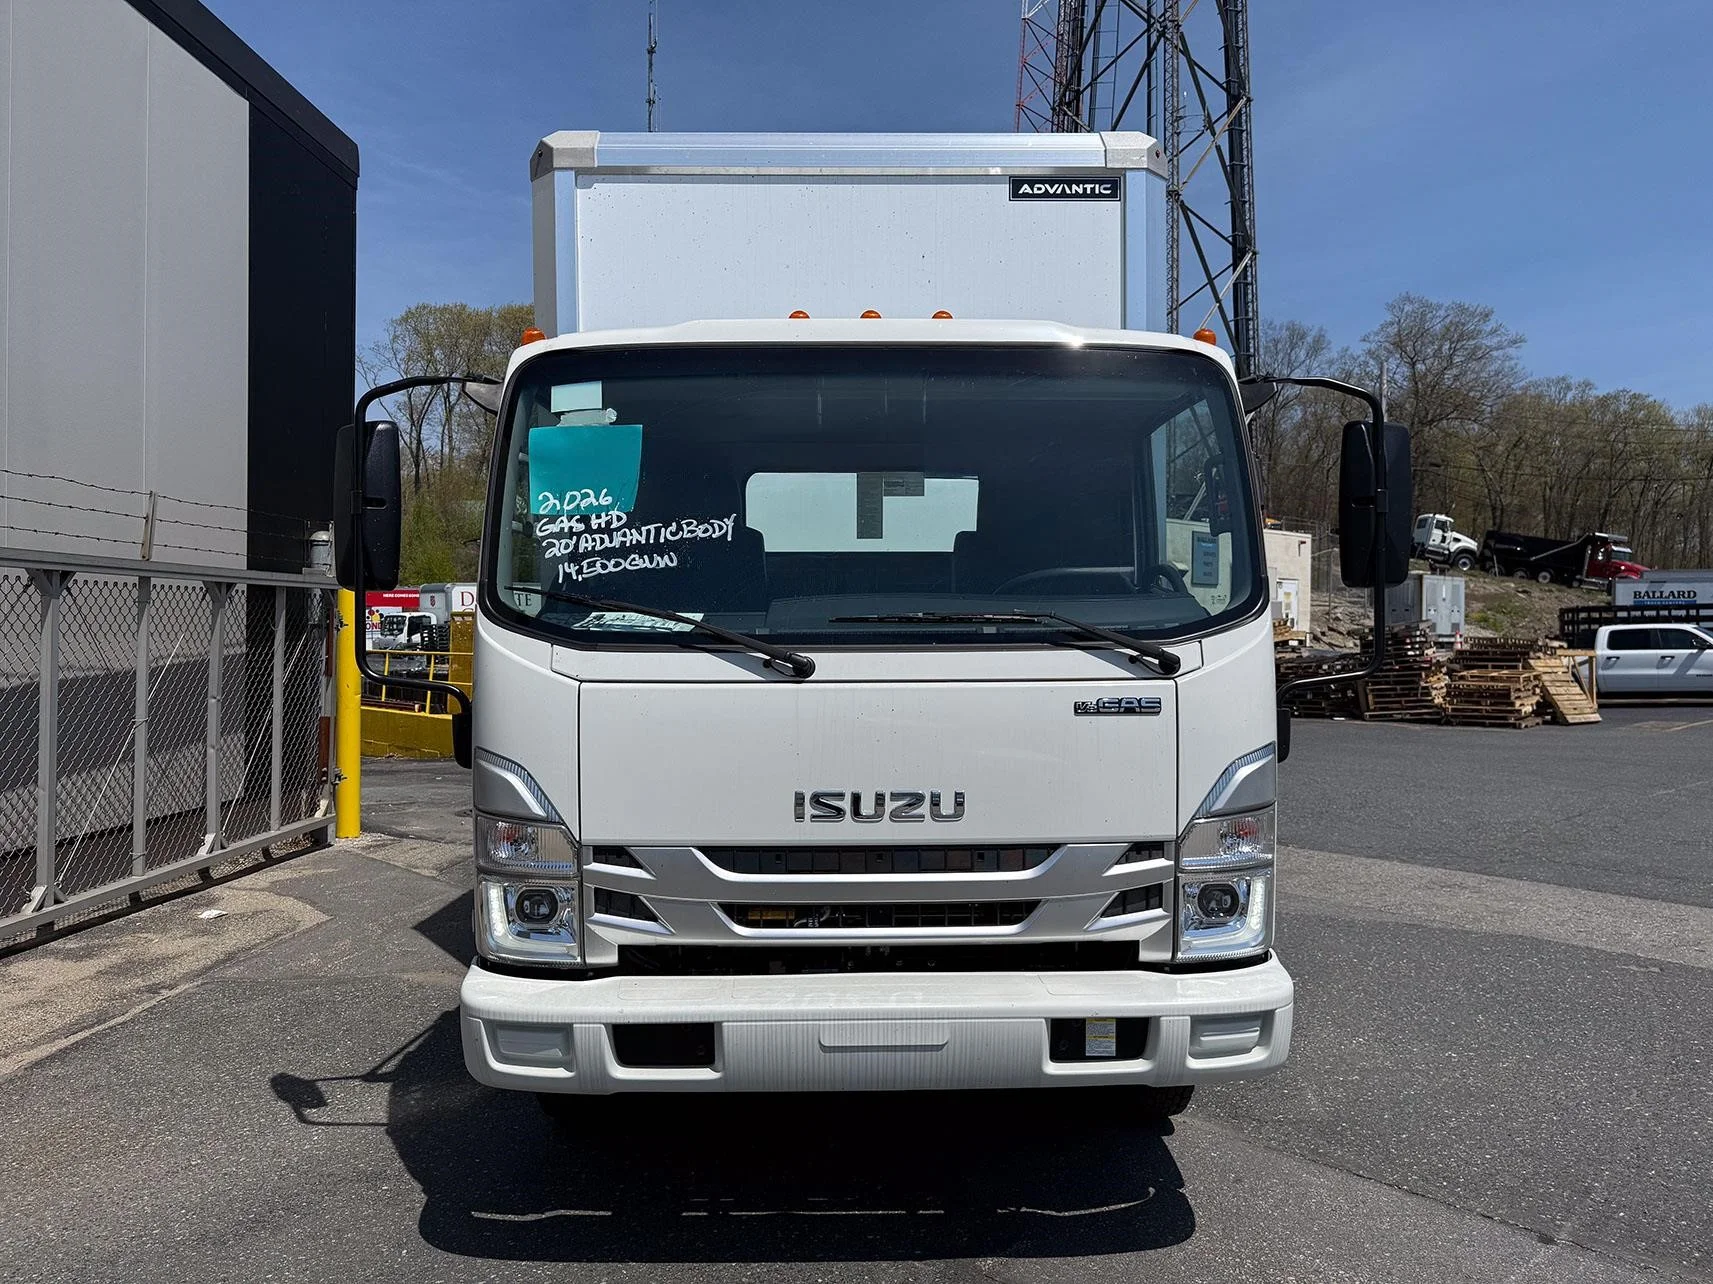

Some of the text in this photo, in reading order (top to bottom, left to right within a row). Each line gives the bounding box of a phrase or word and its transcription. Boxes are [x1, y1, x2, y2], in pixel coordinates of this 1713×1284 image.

[1018, 183, 1112, 195] ADVANTIC
[538, 488, 613, 514] 2026
[535, 513, 628, 537] GAS HD
[1633, 590, 1697, 599] BALLARD
[1097, 697, 1162, 713] GAS
[794, 790, 966, 823] ISUZU
